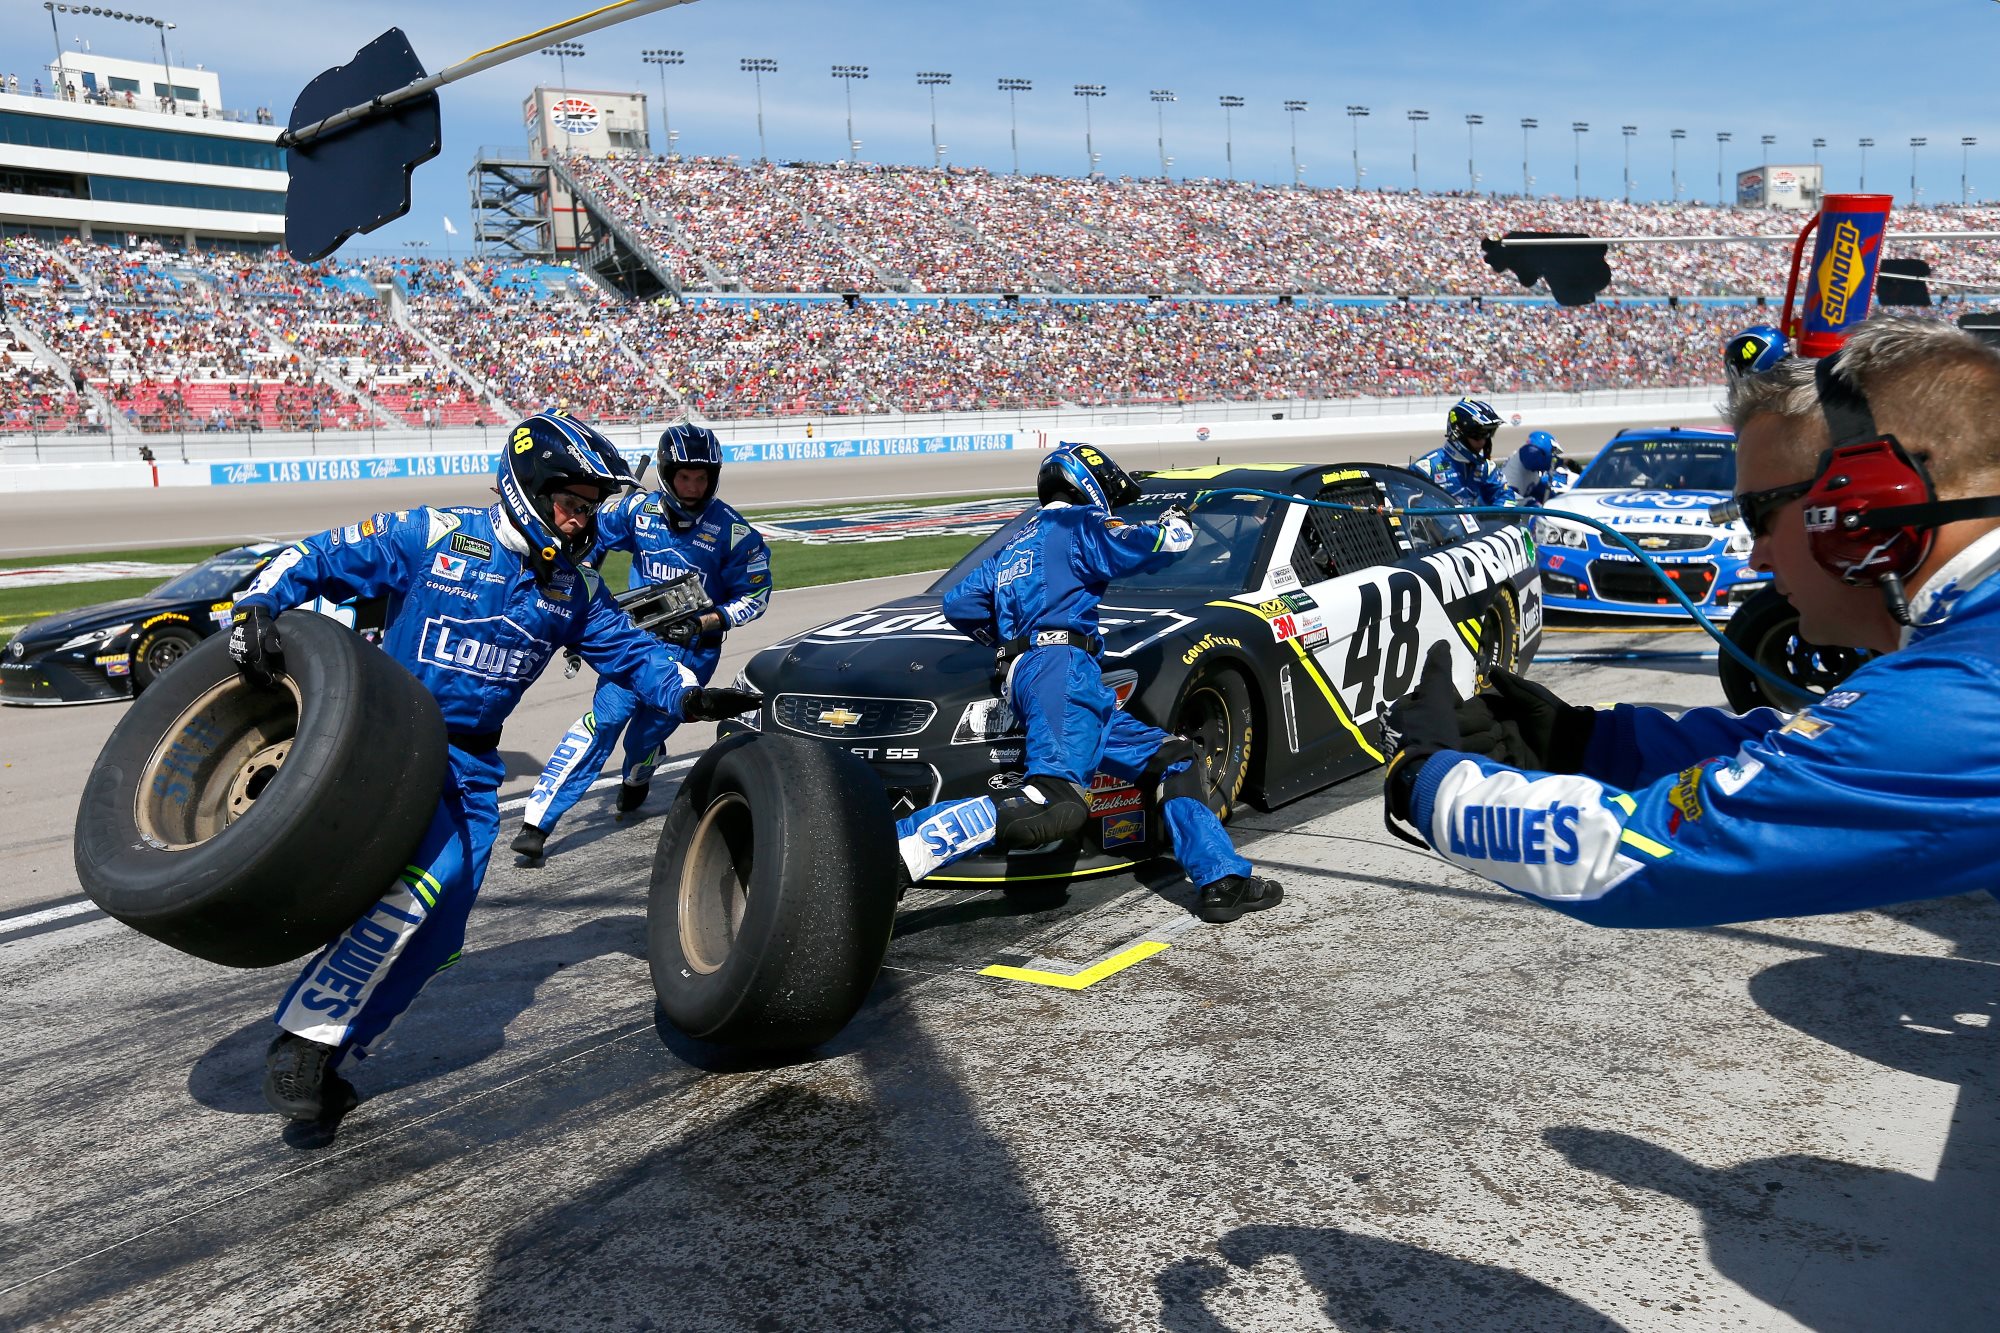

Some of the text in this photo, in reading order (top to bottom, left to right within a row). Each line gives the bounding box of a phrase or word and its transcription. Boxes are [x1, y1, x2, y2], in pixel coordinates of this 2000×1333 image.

[1824, 226, 1858, 322] SUNOCO
[1741, 341, 1758, 360] 48
[513, 427, 534, 455] 48
[269, 463, 300, 482] LAS
[307, 460, 360, 481] VEGAS
[407, 456, 438, 476] LAS
[440, 454, 490, 475] VEGAS
[762, 444, 784, 460] LAS
[787, 441, 826, 460] VEGAS
[859, 439, 880, 456] LAS
[883, 438, 919, 455] VEGAS
[950, 436, 970, 451] LAS
[973, 434, 1007, 450] VEGAS
[1080, 448, 1104, 466] 48
[1137, 492, 1188, 501] STER
[1421, 525, 1531, 605] KOBALT
[1548, 556, 1564, 568] 47
[1600, 553, 1683, 564] CHEVOLET
[426, 581, 479, 601] GOODYEAR
[536, 599, 573, 618] KOBALT
[142, 612, 190, 630] GOODYEAR
[1273, 615, 1297, 640] 3M
[434, 627, 541, 675] LOWE'S
[1182, 633, 1243, 666] GOODYEAR
[1342, 572, 1422, 718] 48
[95, 653, 130, 665] MOOG
[885, 748, 919, 760] SS
[1090, 792, 1143, 813] Edelbrock
[1105, 822, 1144, 839] SUNOCO
[1450, 800, 1580, 866] LOWE'S
[302, 901, 423, 1019] LOWE'S
